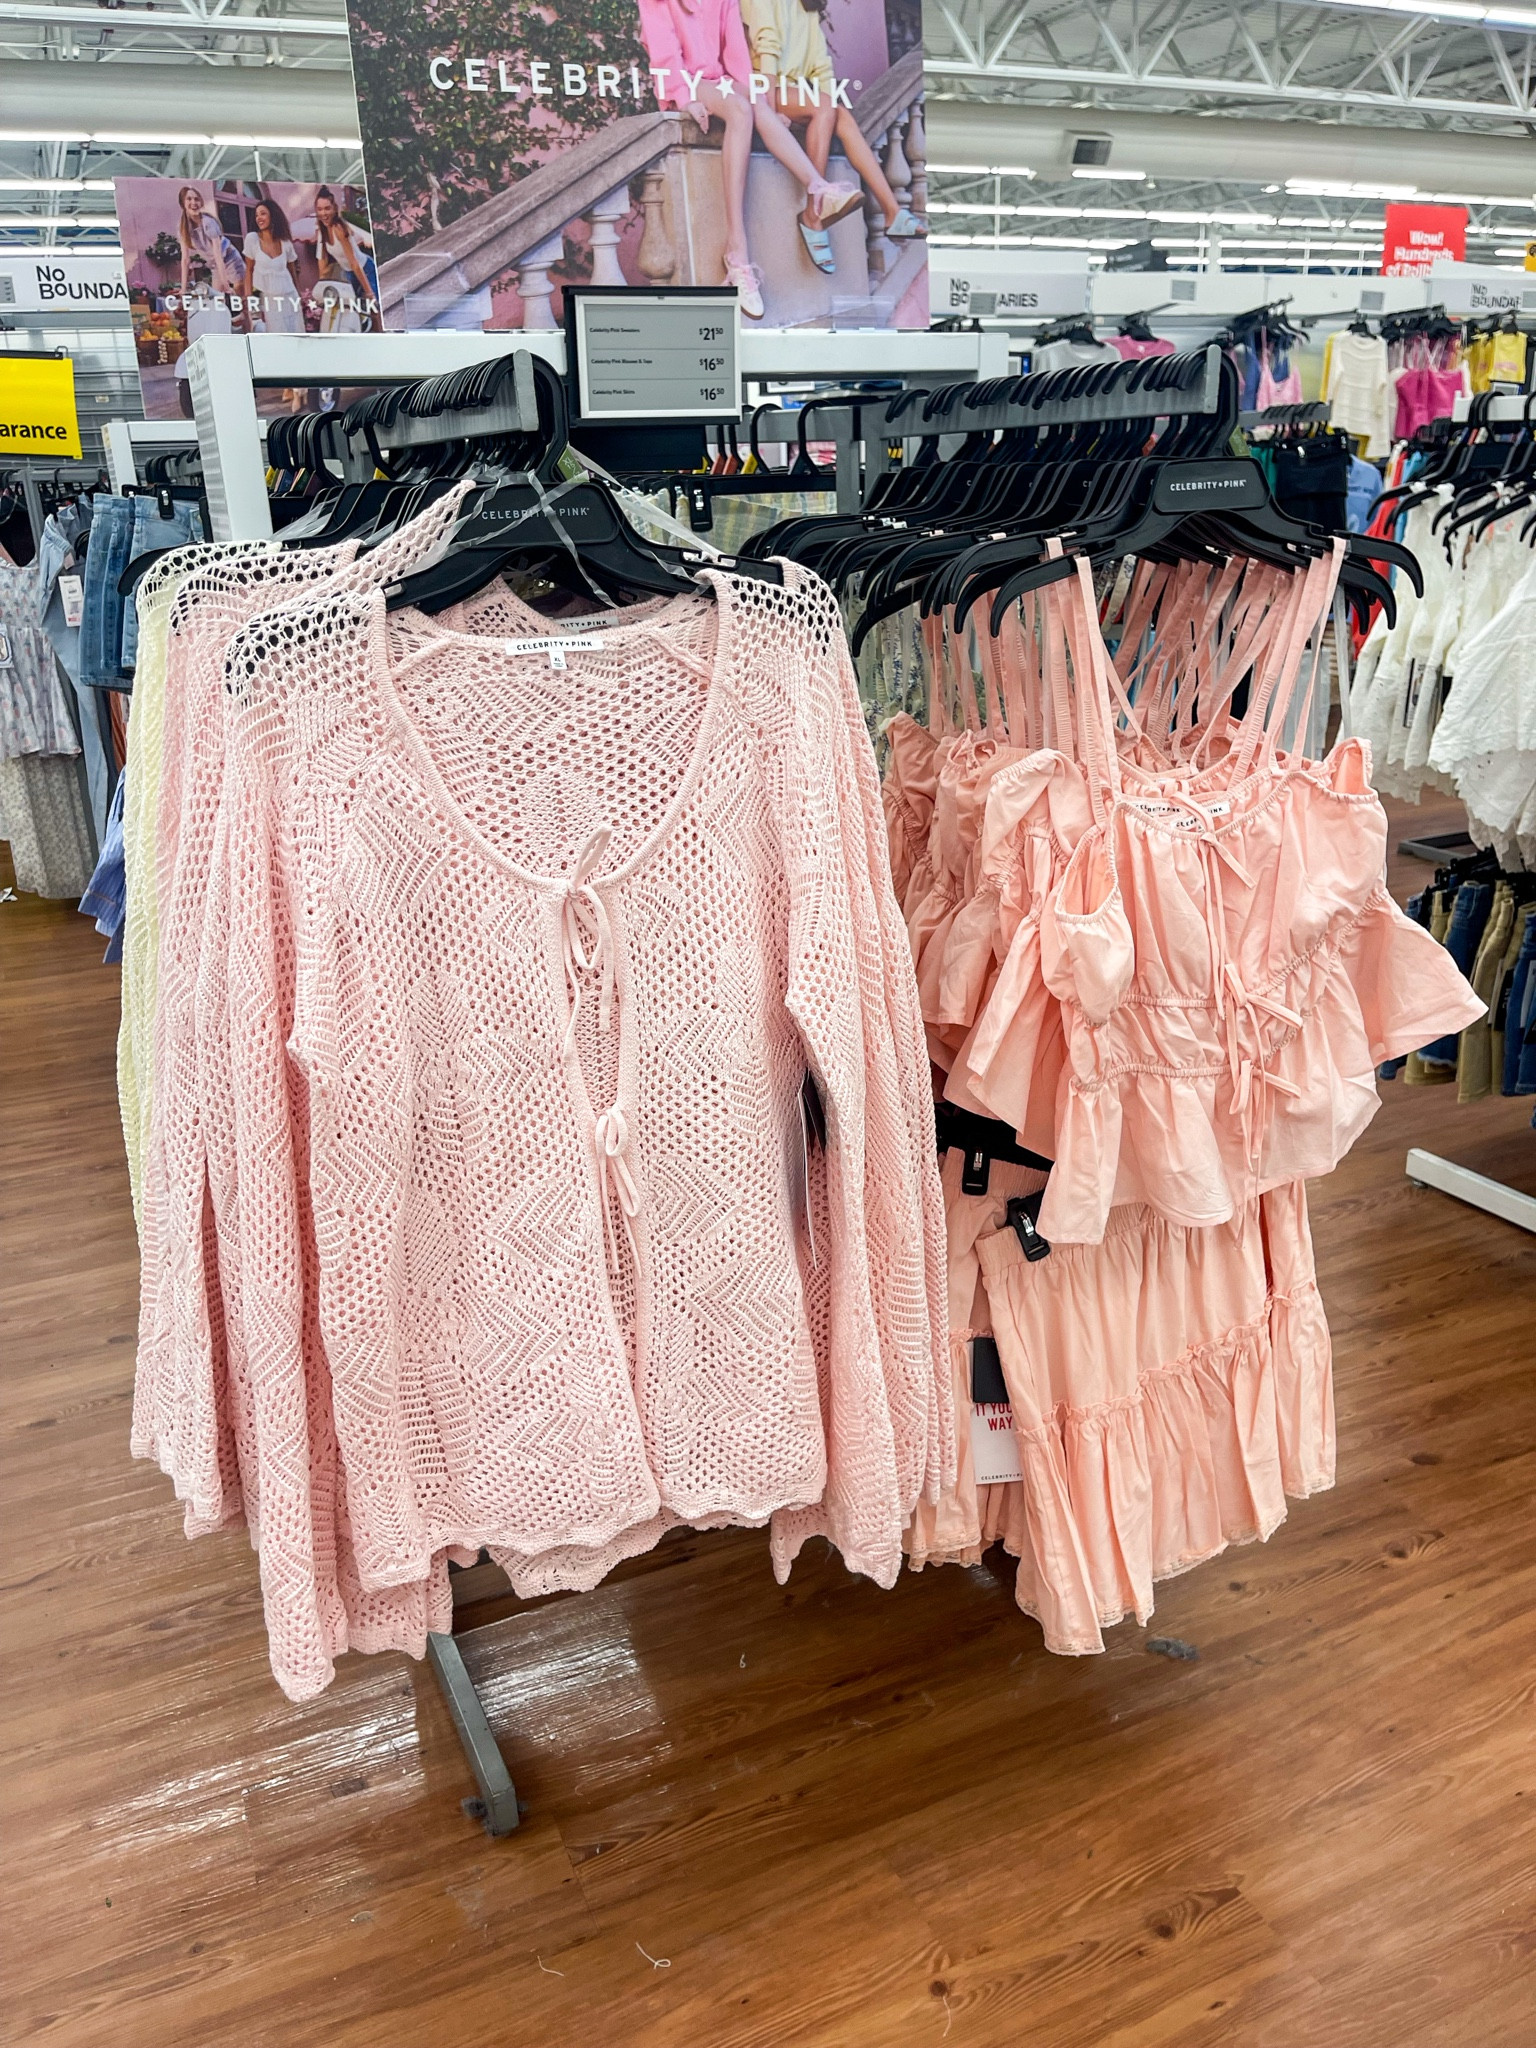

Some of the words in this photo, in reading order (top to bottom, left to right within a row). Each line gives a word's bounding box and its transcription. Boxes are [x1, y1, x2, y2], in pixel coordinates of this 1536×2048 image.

[429, 56, 703, 99] CELEBRITY
[1409, 230, 1445, 246] Wow!
[164, 294, 302, 313] CELEBRITY
[323, 298, 379, 314] PINK
[1170, 481, 1216, 491] CELEBRITY
[516, 641, 564, 651] CELEBRITY
[987, 1416, 1013, 1432] WAY
